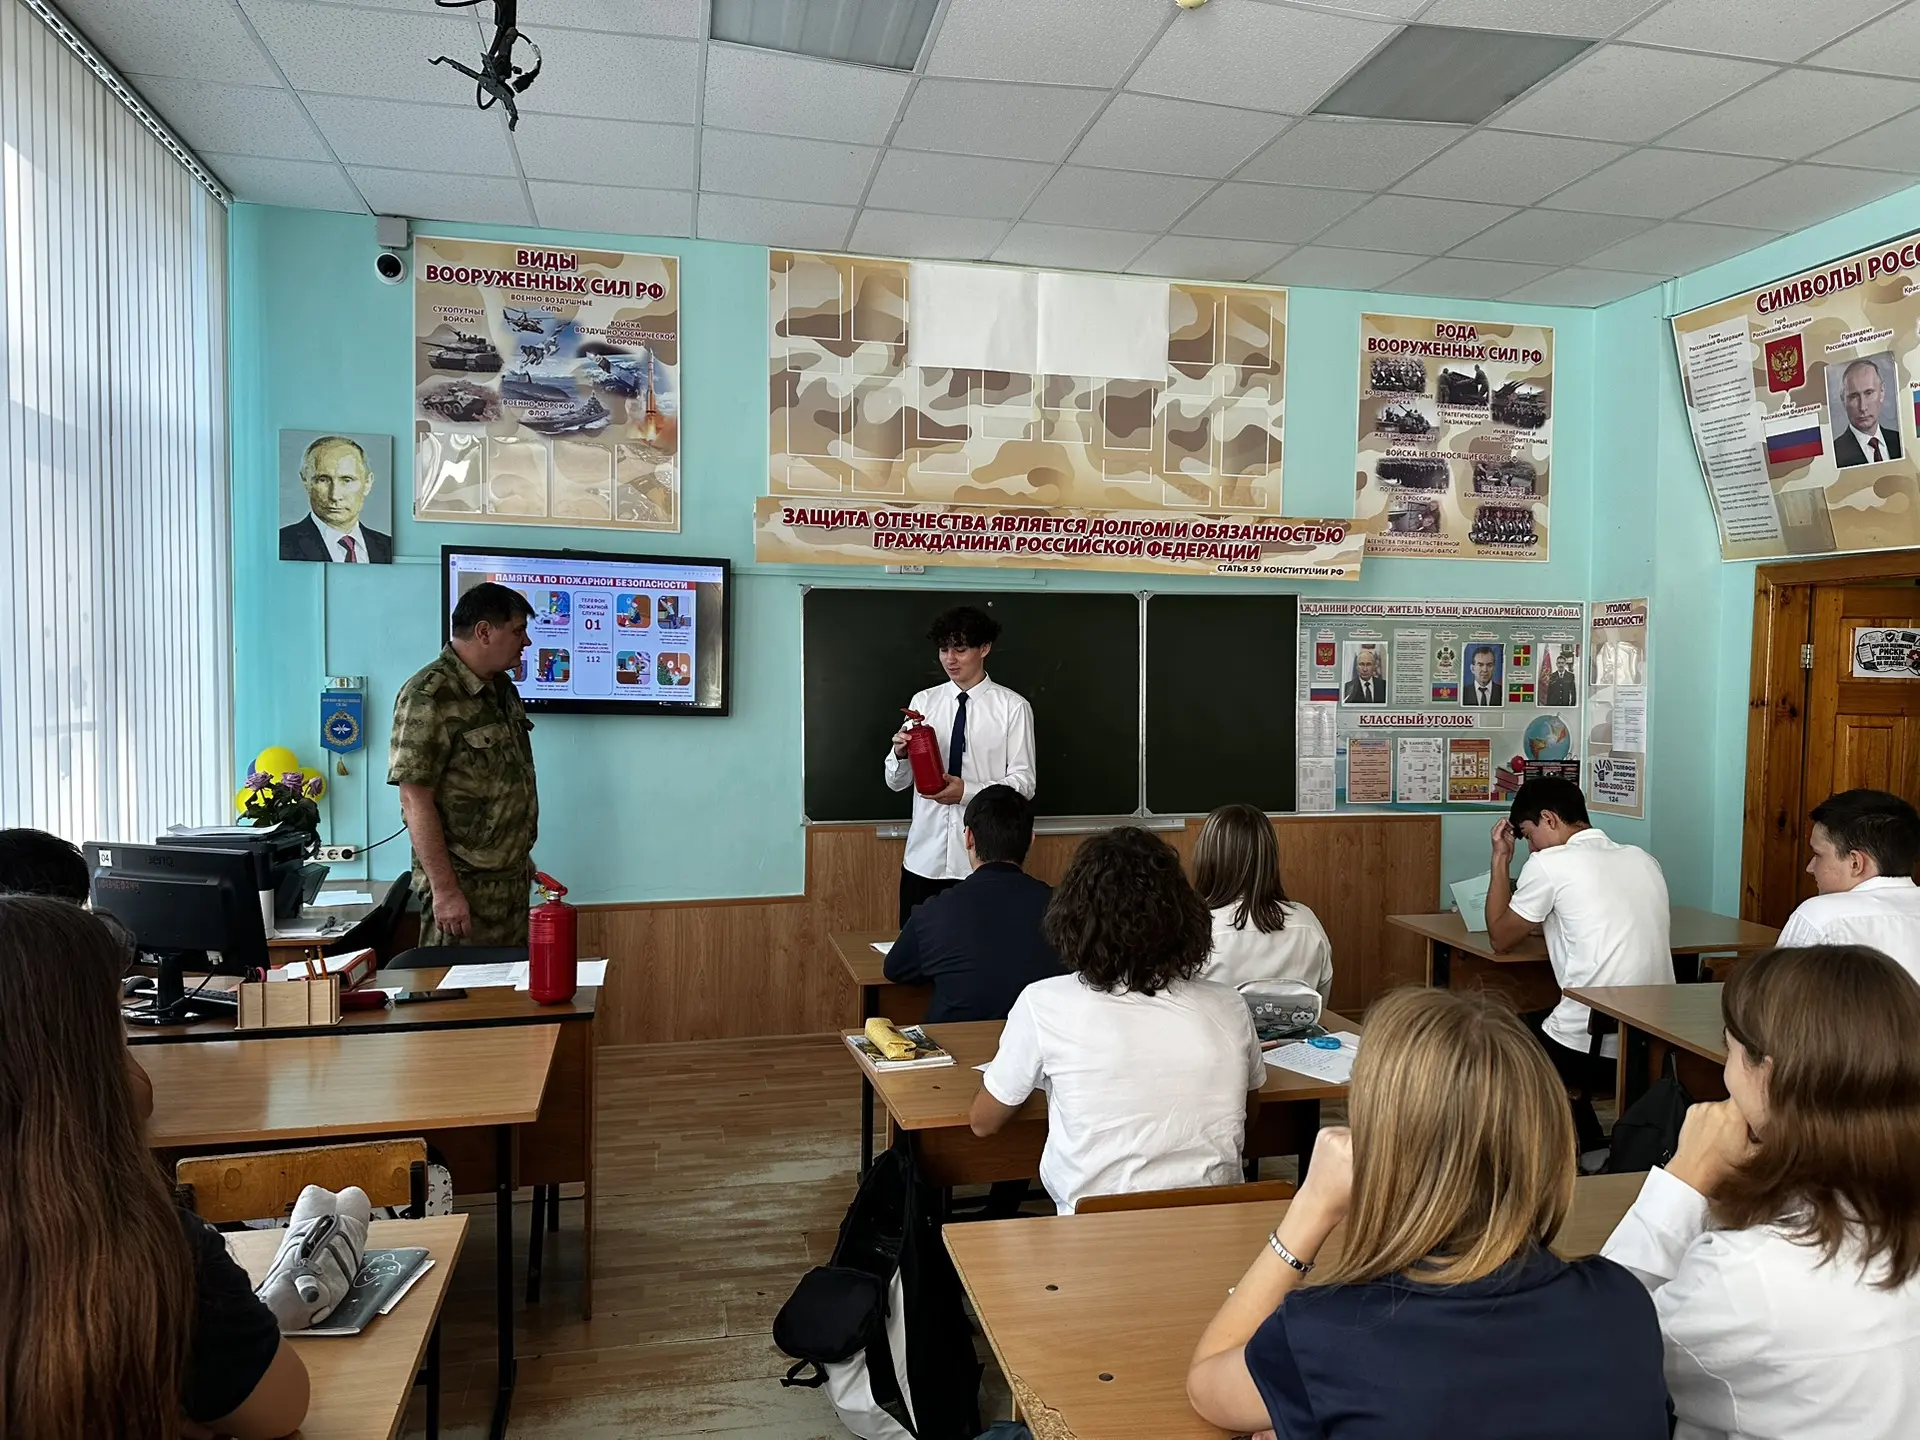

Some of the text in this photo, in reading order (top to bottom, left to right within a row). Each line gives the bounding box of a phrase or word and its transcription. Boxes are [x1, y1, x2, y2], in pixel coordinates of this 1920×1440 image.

[517, 250, 577, 270] ВИДЫ
[426, 266, 663, 299] ВООРУЖЕННЫХ СИЛ РФ
[1757, 262, 1862, 314] СИМВОЛЫ
[433, 306, 485, 316] СУХОПУТНЫЕ
[541, 305, 563, 313] СИЛЫ
[443, 315, 475, 324] ВОЙСКА
[611, 321, 641, 329] ВОЙСКА
[1775, 317, 1787, 326] Герб
[1436, 324, 1477, 341] РОДА
[1752, 318, 1812, 338] Российской Федерации
[1841, 328, 1873, 341] Президент
[607, 338, 645, 347] ОБОРОНЫ
[1689, 332, 1745, 352] Российской Федерации
[1825, 330, 1893, 352] Российской Федерации
[1368, 338, 1543, 364] ВООРУЖЕННЫХ СИЛ РФ
[1760, 403, 1821, 421] Российской Федерации
[1386, 448, 1418, 458] ВОЙСКА
[1419, 451, 1430, 459] НЕ
[783, 507, 1344, 544] ЗАЩИТА ОТЕЧЕСТВА ЯВЛЯЕТСЯ ДОЛГОМ И ОБЯЗАННОСТЬЮ
[873, 531, 1260, 562] ГРАЖДАНИНА РОССИЙСКОЙ ФЕДЕРАЦИИ
[1217, 564, 1344, 577] СТАТЬЯ 59 КОНСТИТУЦИИ РФ
[495, 573, 541, 584] ПАМЯТКА
[543, 575, 557, 585] ПО
[616, 578, 688, 590] БЕЗОПАСНОСТИ
[578, 603, 609, 611] ПОЖАРНОЙ
[1350, 604, 1386, 615] РОССИИ,
[1387, 605, 1423, 614] ЖИТЕЛЬ
[1424, 605, 1460, 616] КУБАНИ,
[1462, 605, 1546, 617] КРАСНОАРМЕЙСКОГО
[1547, 606, 1580, 617] РАЙОНА
[1605, 602, 1631, 614] УГОЛОК
[585, 618, 602, 630] 01
[1592, 615, 1645, 627] БЕЗОПАСНОСТИ
[586, 655, 601, 663] 112
[1360, 713, 1473, 726] КЛАССНЫЙ УГОЛОК
